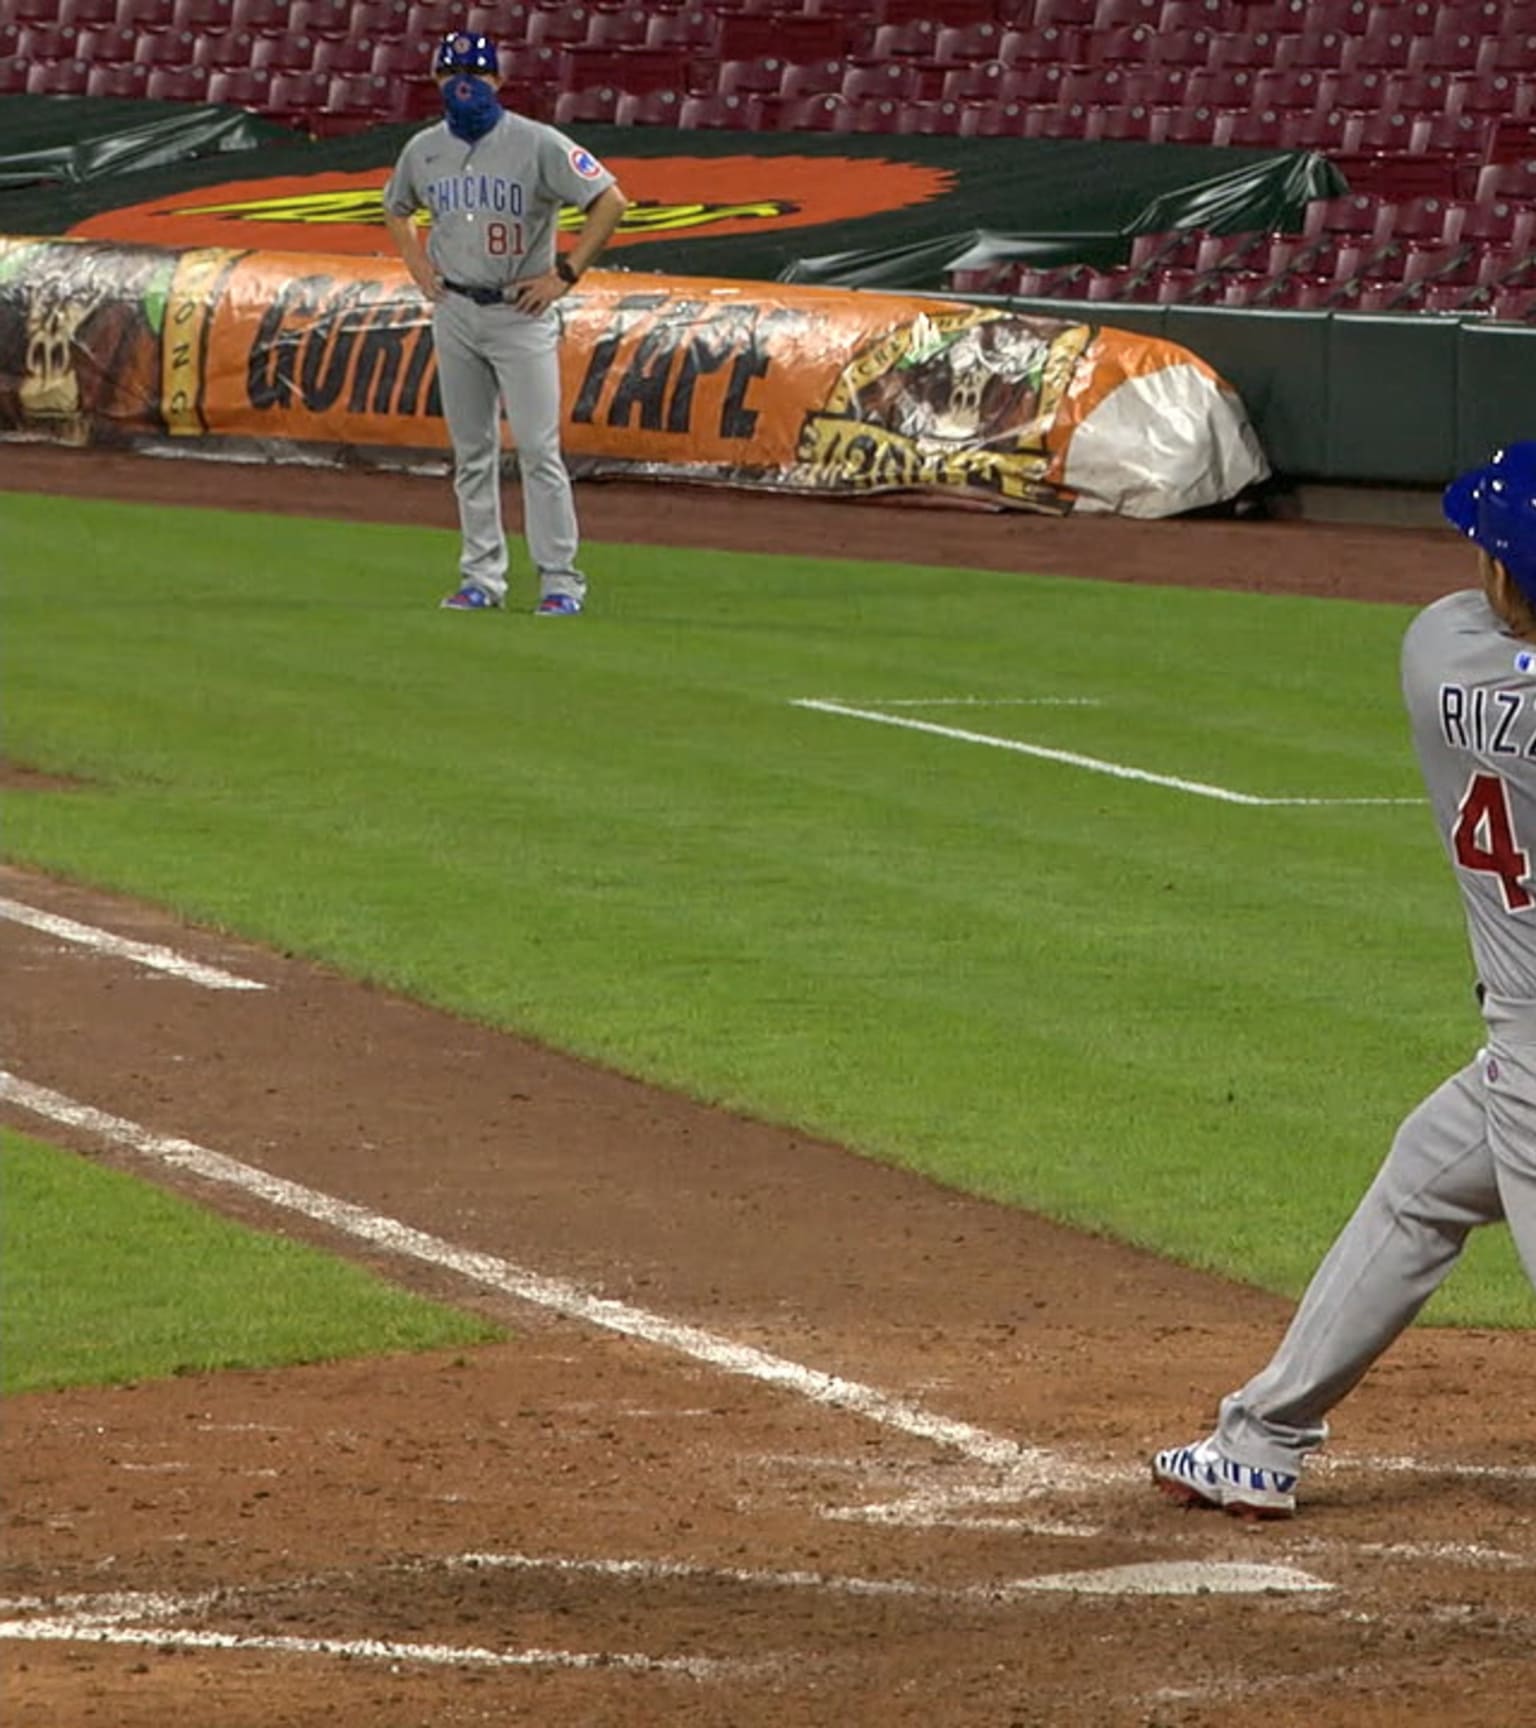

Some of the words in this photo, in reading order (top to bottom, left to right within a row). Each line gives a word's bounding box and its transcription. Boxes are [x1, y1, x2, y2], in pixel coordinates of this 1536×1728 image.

[425, 174, 524, 220] CHICAGO
[487, 222, 525, 256] 81
[247, 275, 446, 417] GORI
[570, 295, 796, 438] TAPE
